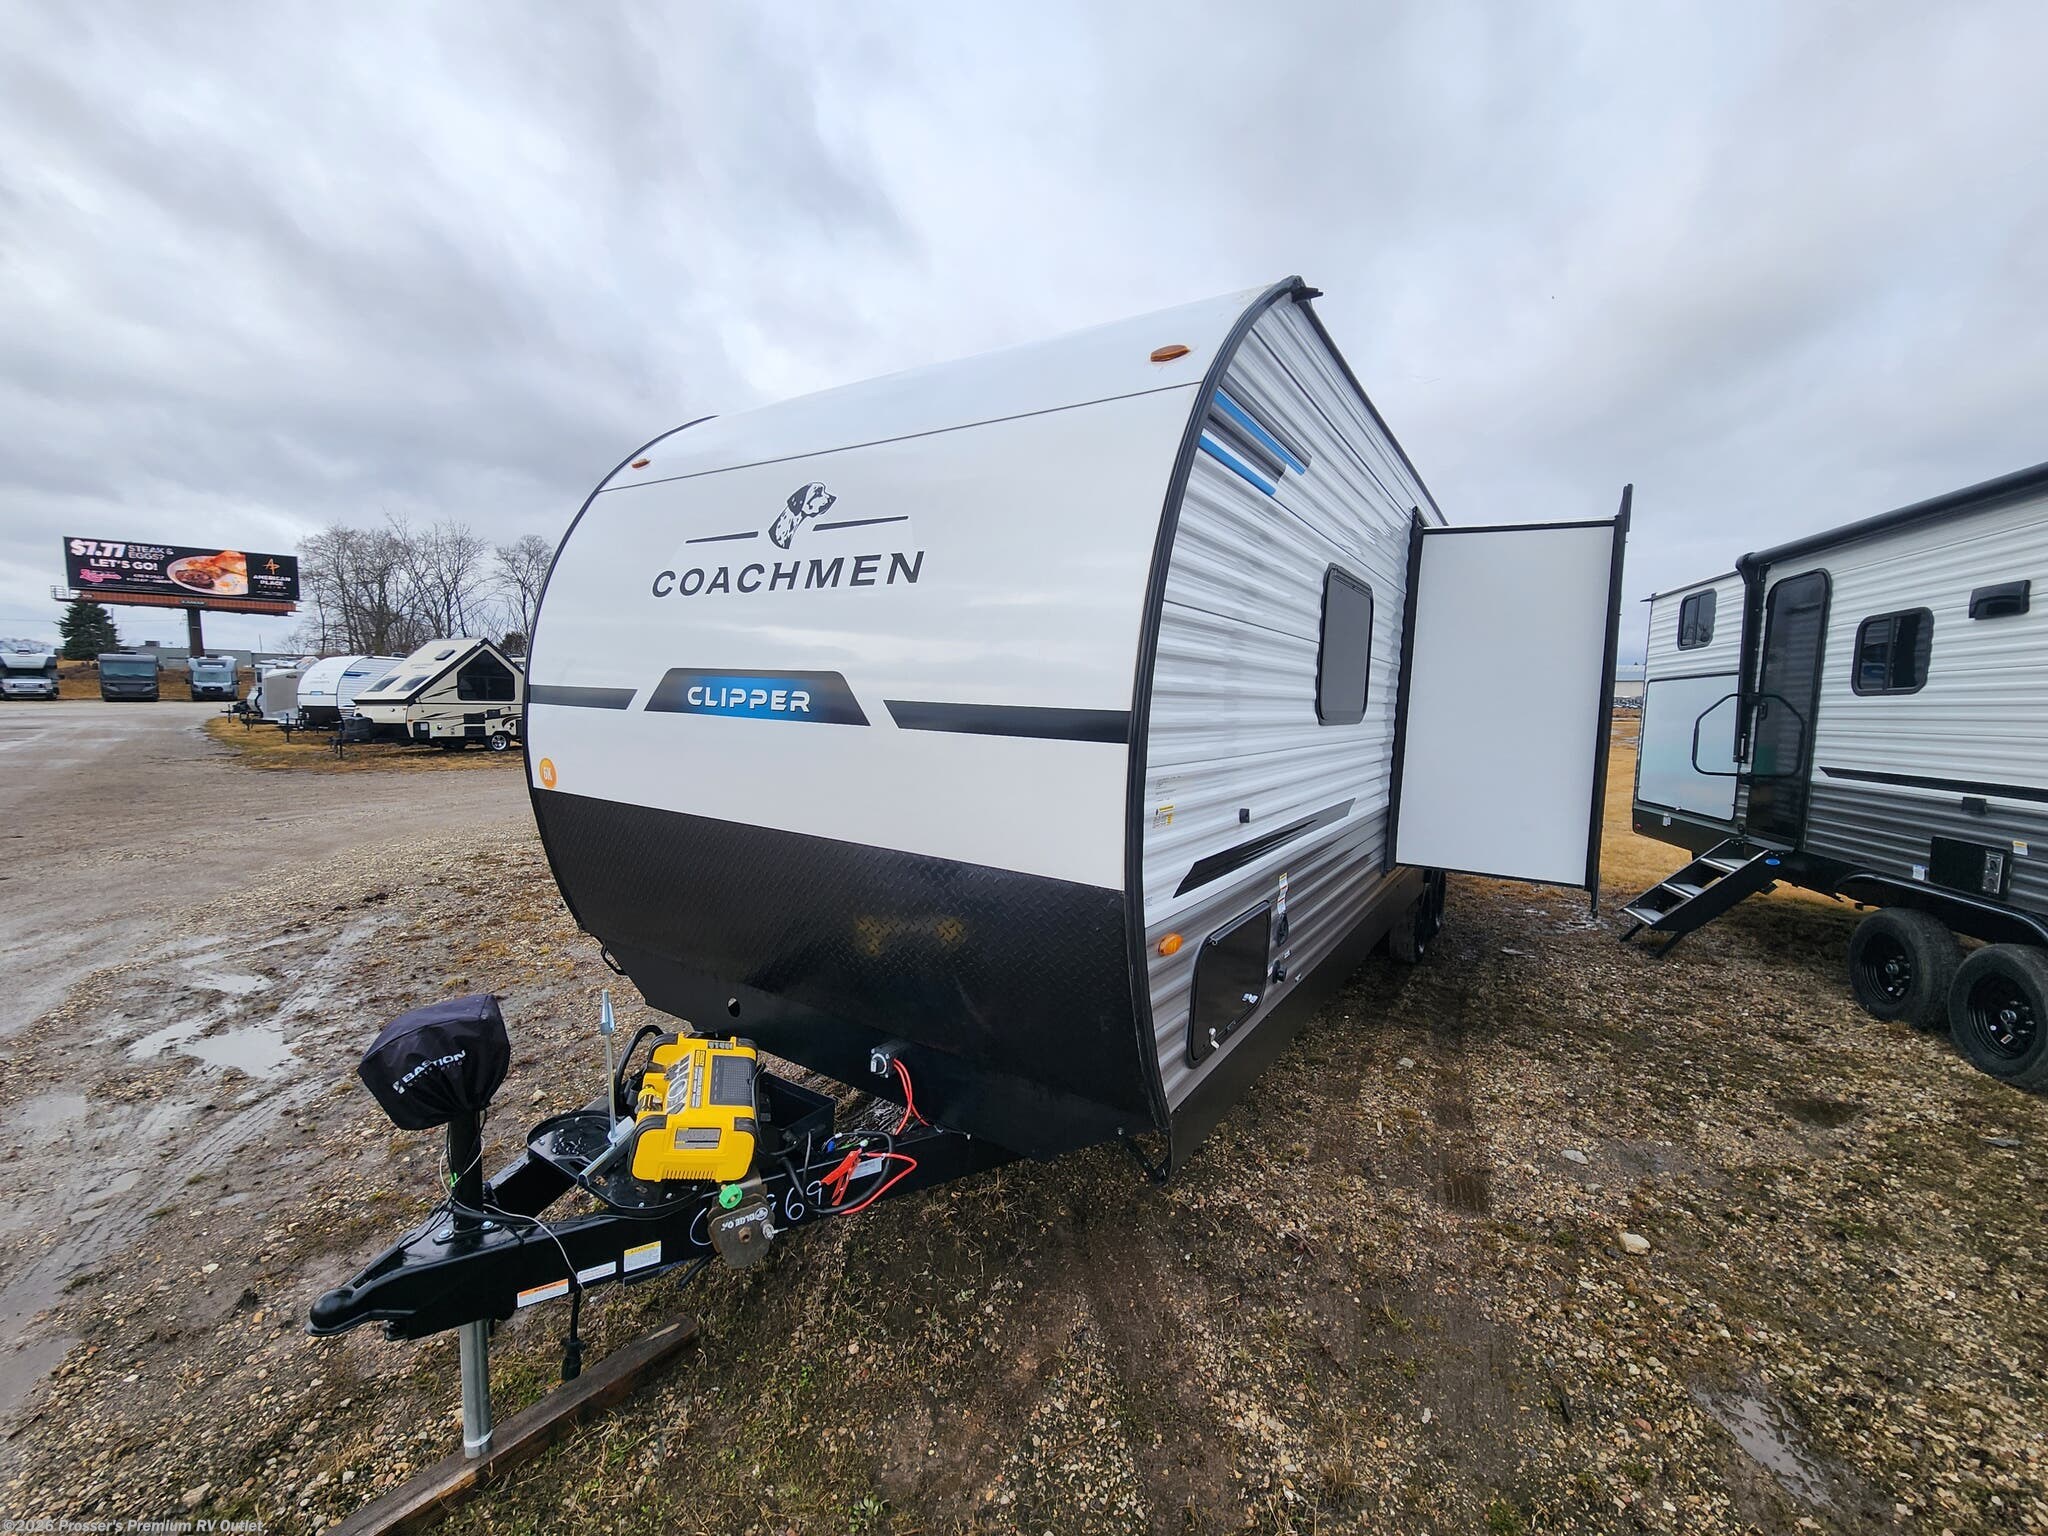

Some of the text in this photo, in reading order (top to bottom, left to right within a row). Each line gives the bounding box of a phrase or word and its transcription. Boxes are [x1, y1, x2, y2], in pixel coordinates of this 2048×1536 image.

[127, 544, 165, 554] STEAK
[127, 551, 165, 560] EGGS?
[90, 558, 158, 571] LET'S GO!
[651, 550, 925, 598] COACHMEN
[687, 686, 811, 712] CLIPPER
[402, 1049, 467, 1083] BASTION
